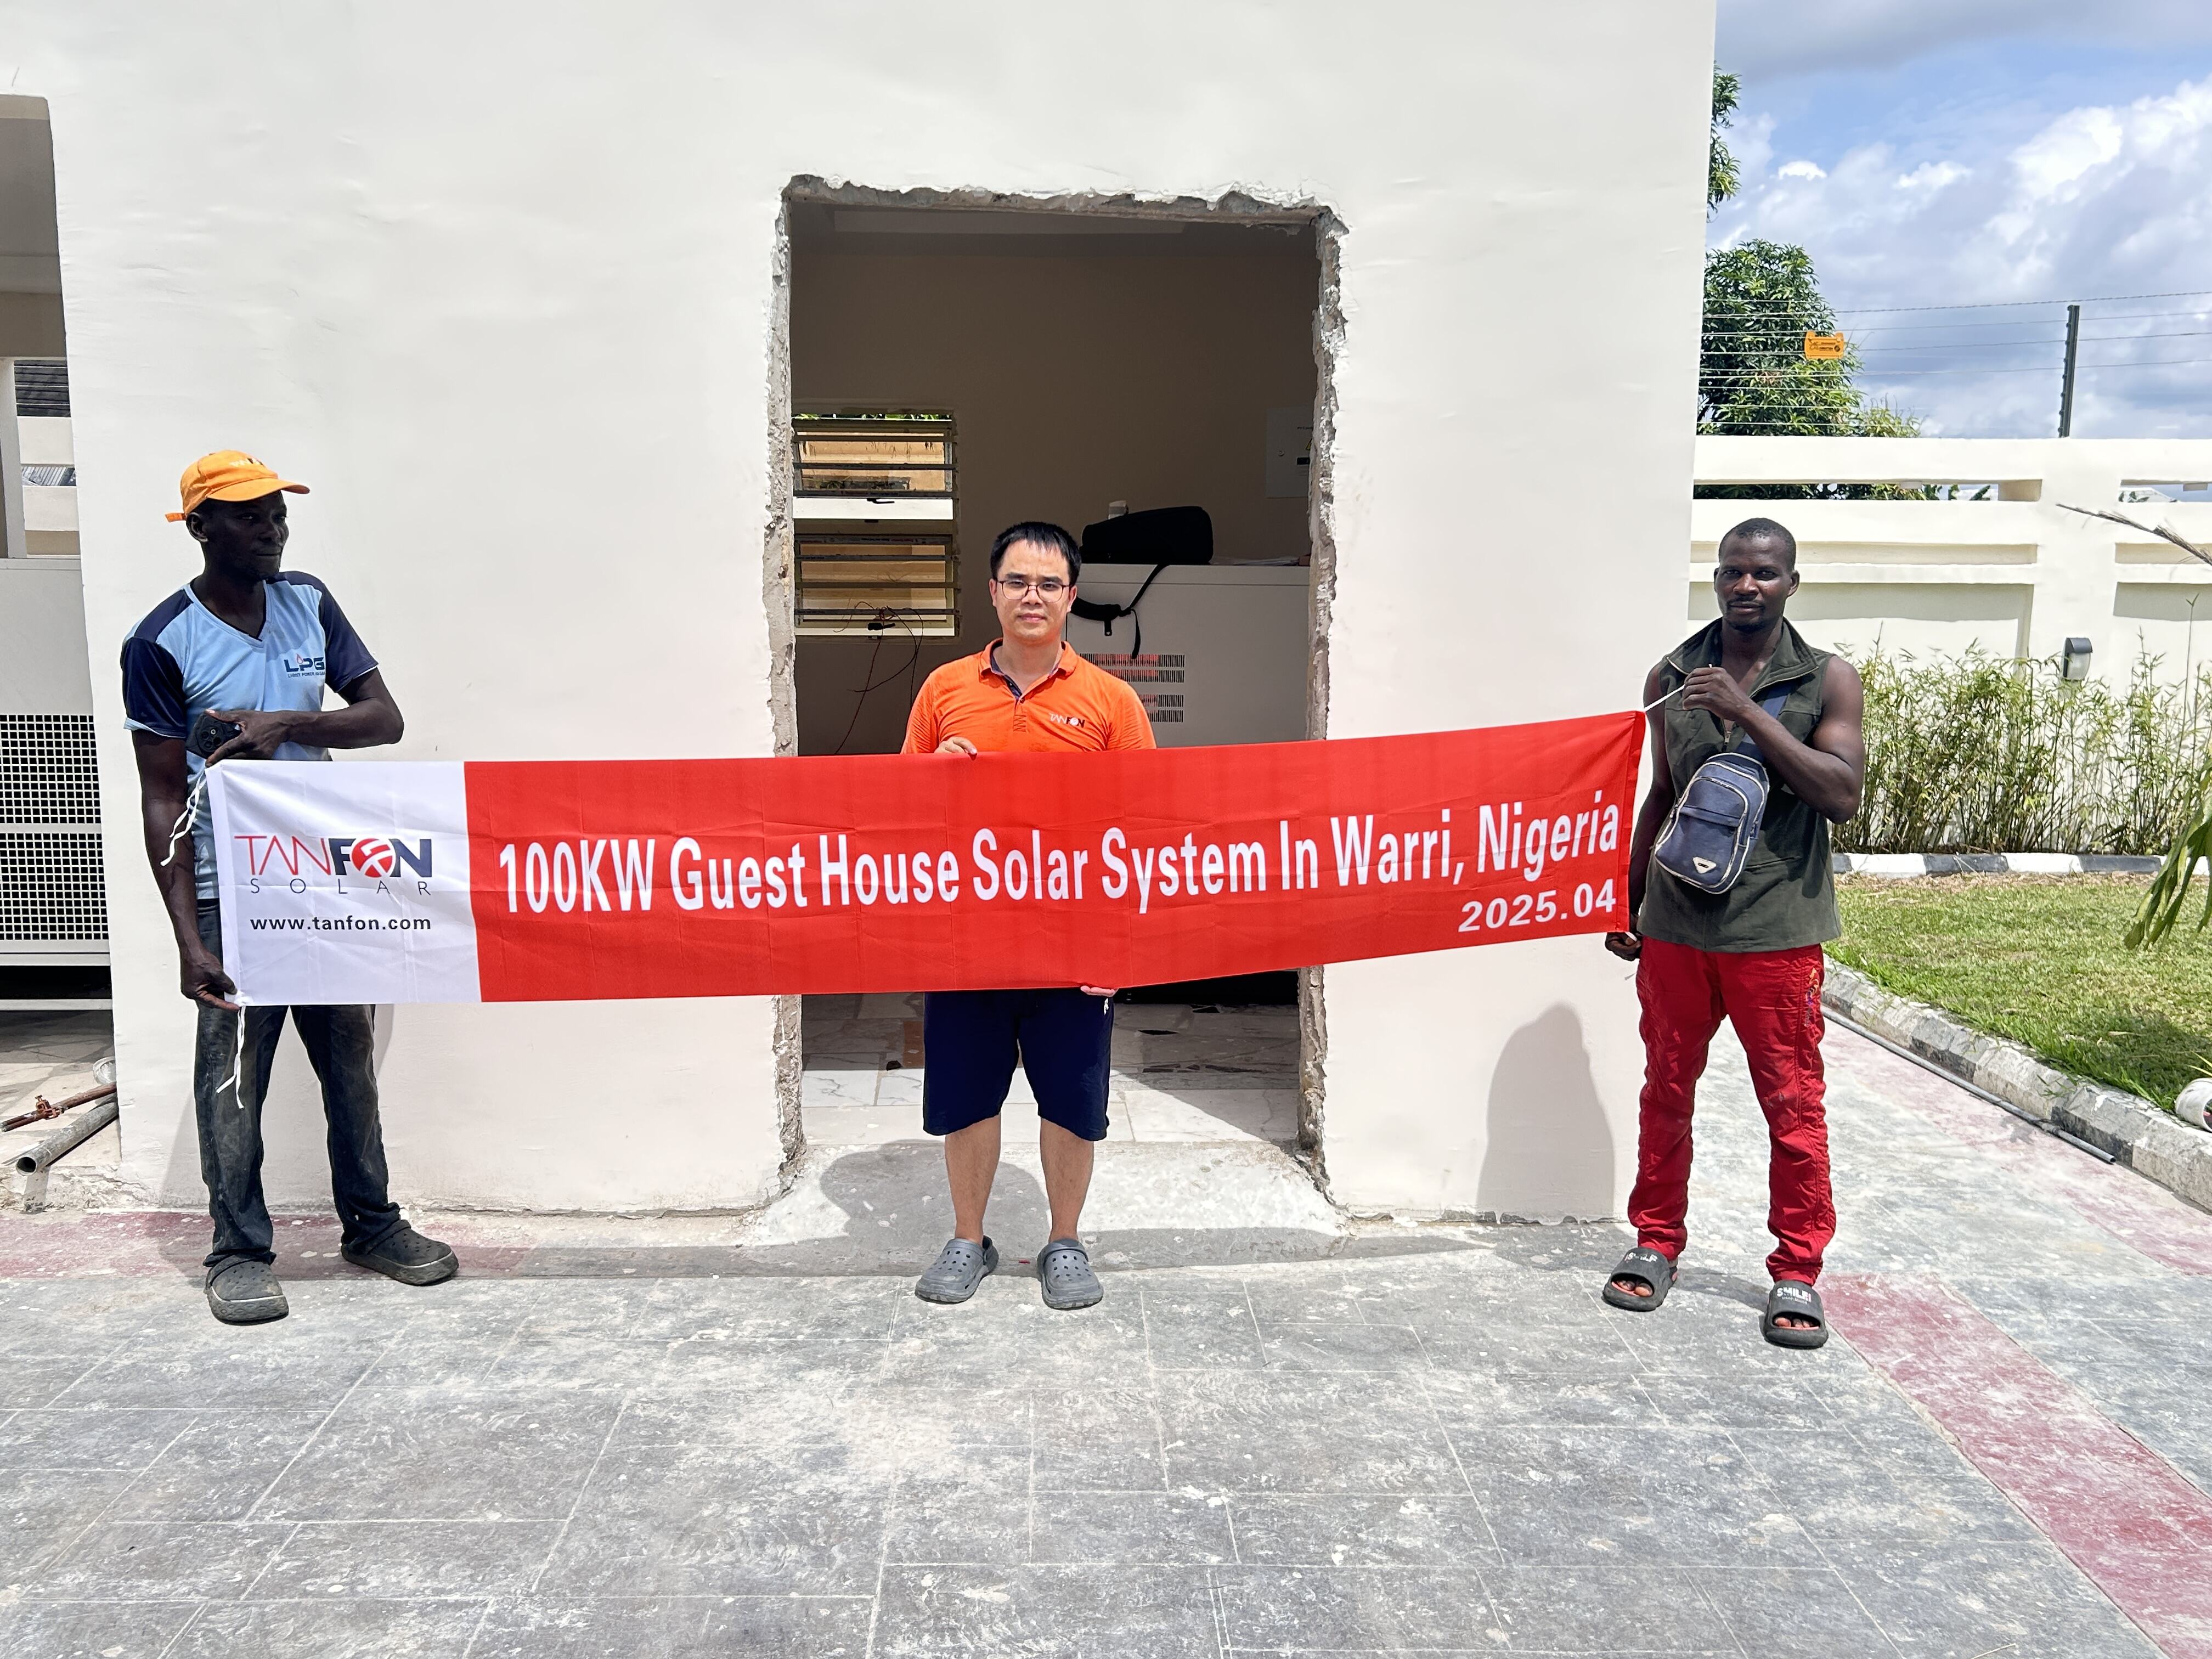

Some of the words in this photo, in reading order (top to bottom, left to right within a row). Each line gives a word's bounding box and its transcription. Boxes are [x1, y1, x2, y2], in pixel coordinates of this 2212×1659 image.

[284, 657, 325, 672] LPG
[1048, 713, 1085, 729] TANFON
[234, 836, 432, 878] TANFON
[500, 838, 656, 913] 100KW
[670, 837, 808, 911] Guest
[819, 834, 960, 906] House
[972, 828, 1088, 900] Solar
[1101, 827, 1266, 914] System
[1280, 820, 1318, 890] In
[1330, 808, 1464, 885] Warri,
[1477, 790, 1619, 882] Nigeria
[251, 878, 432, 895] SOLAR
[1458, 878, 1616, 933] 2025.04
[250, 915, 431, 930] www.tanfon.com
